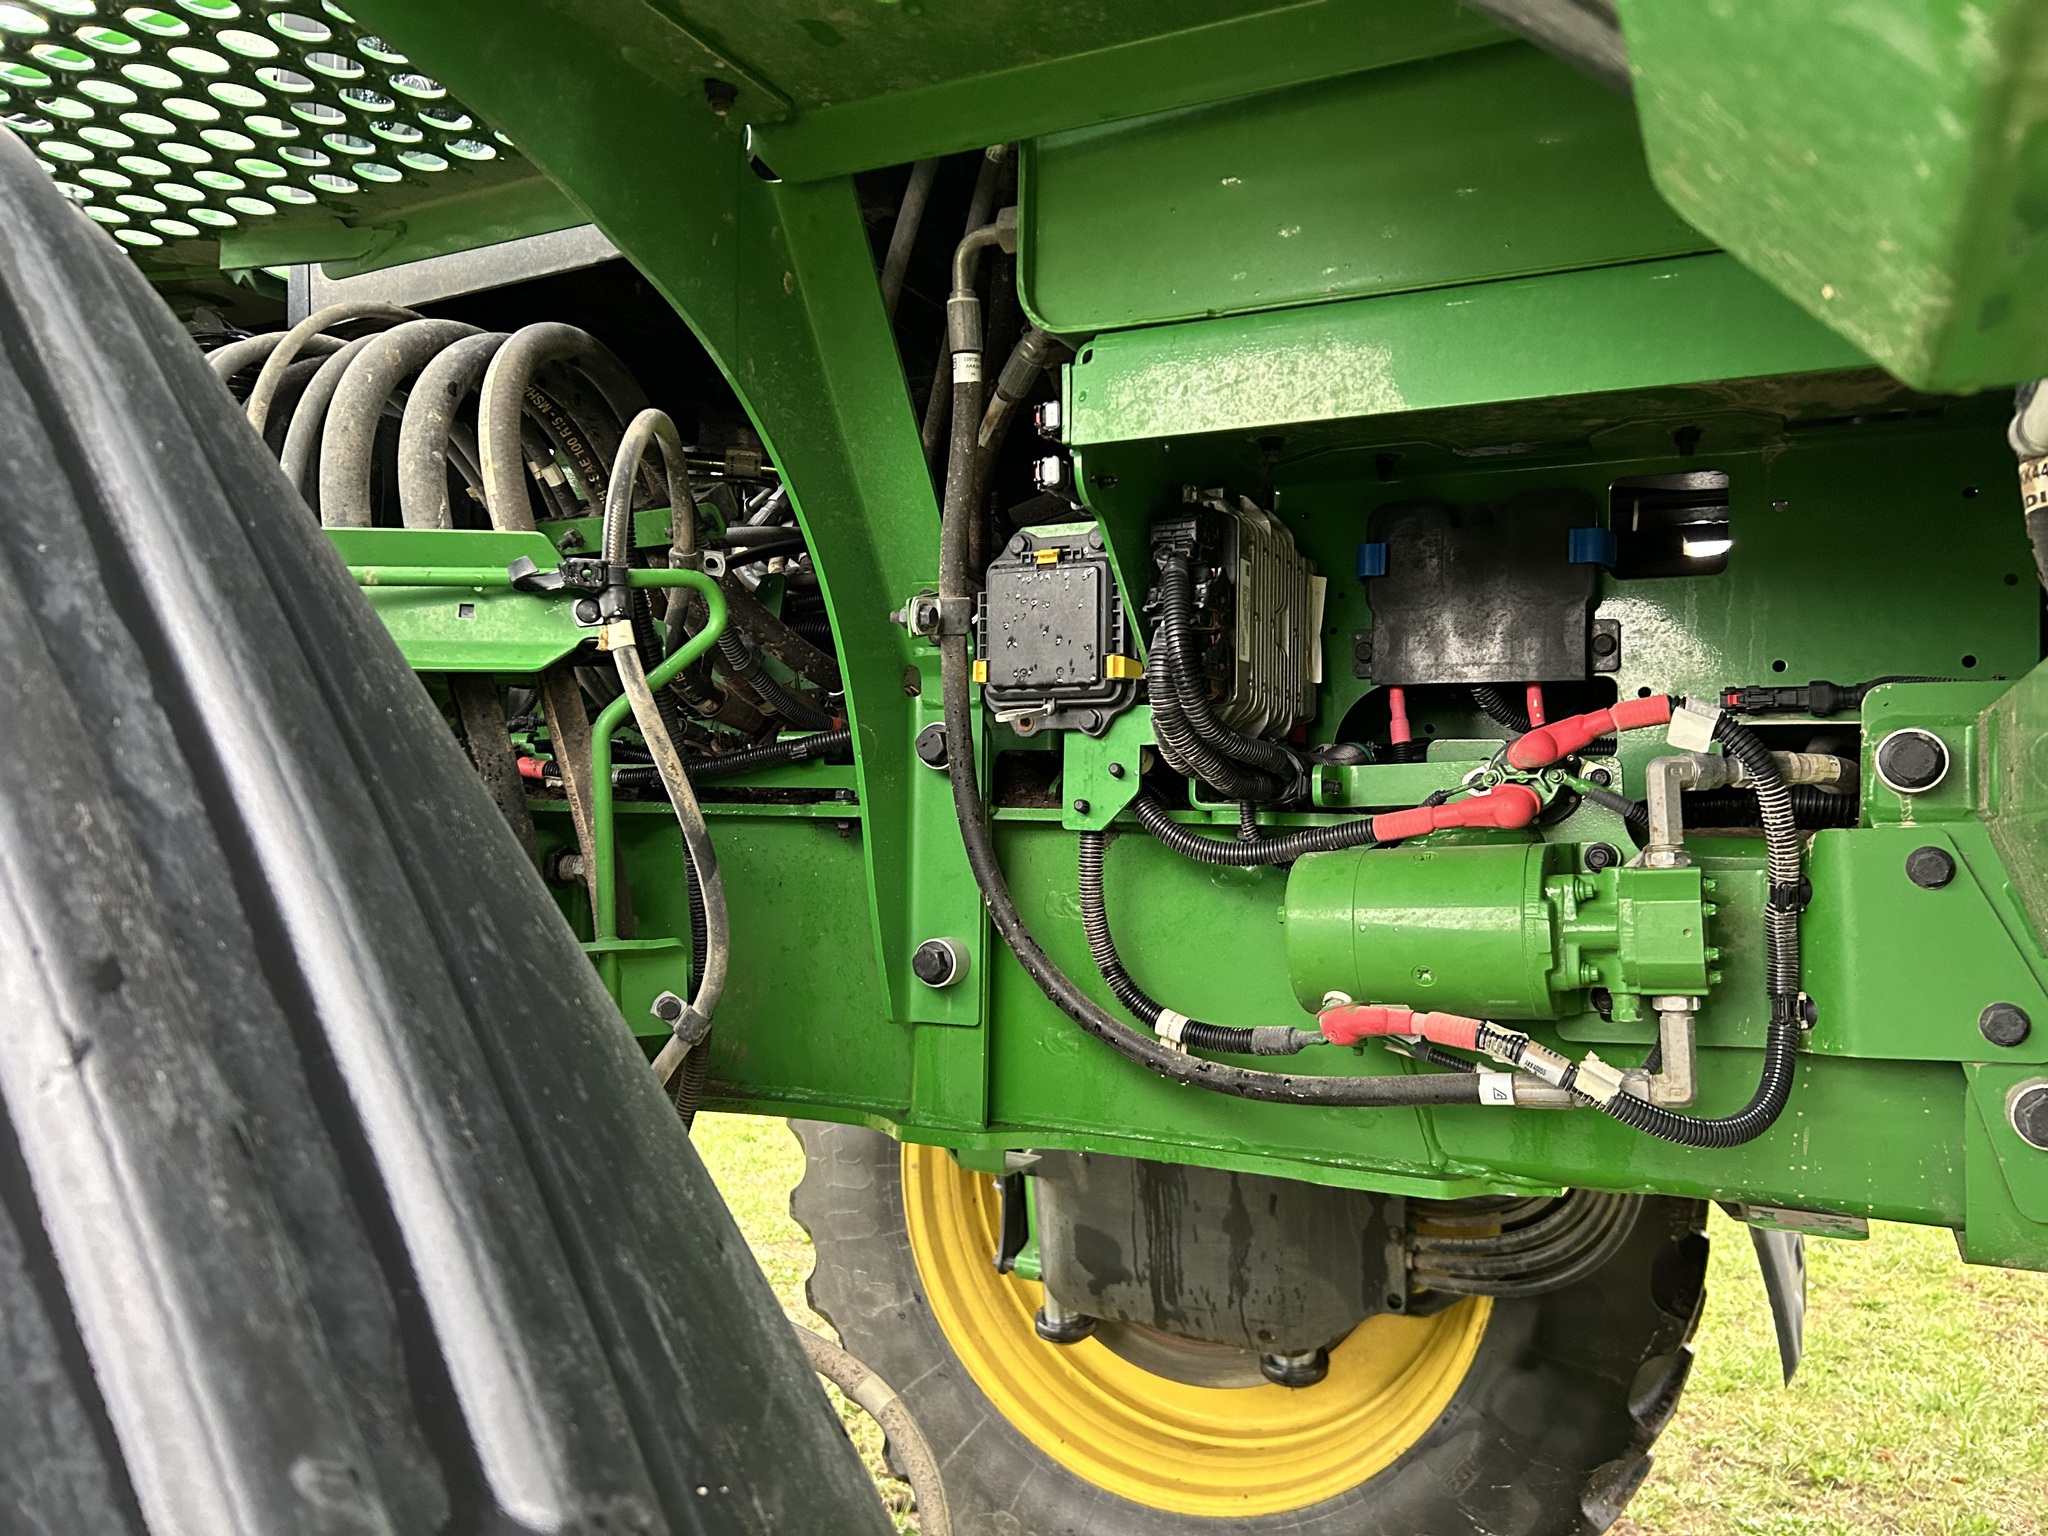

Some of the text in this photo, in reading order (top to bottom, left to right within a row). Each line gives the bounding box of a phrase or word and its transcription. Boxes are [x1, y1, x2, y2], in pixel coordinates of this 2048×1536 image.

[551, 416, 572, 438] R15
[566, 437, 585, 458] 100
[578, 457, 600, 482] SAE
[569, 792, 580, 816] MPa
